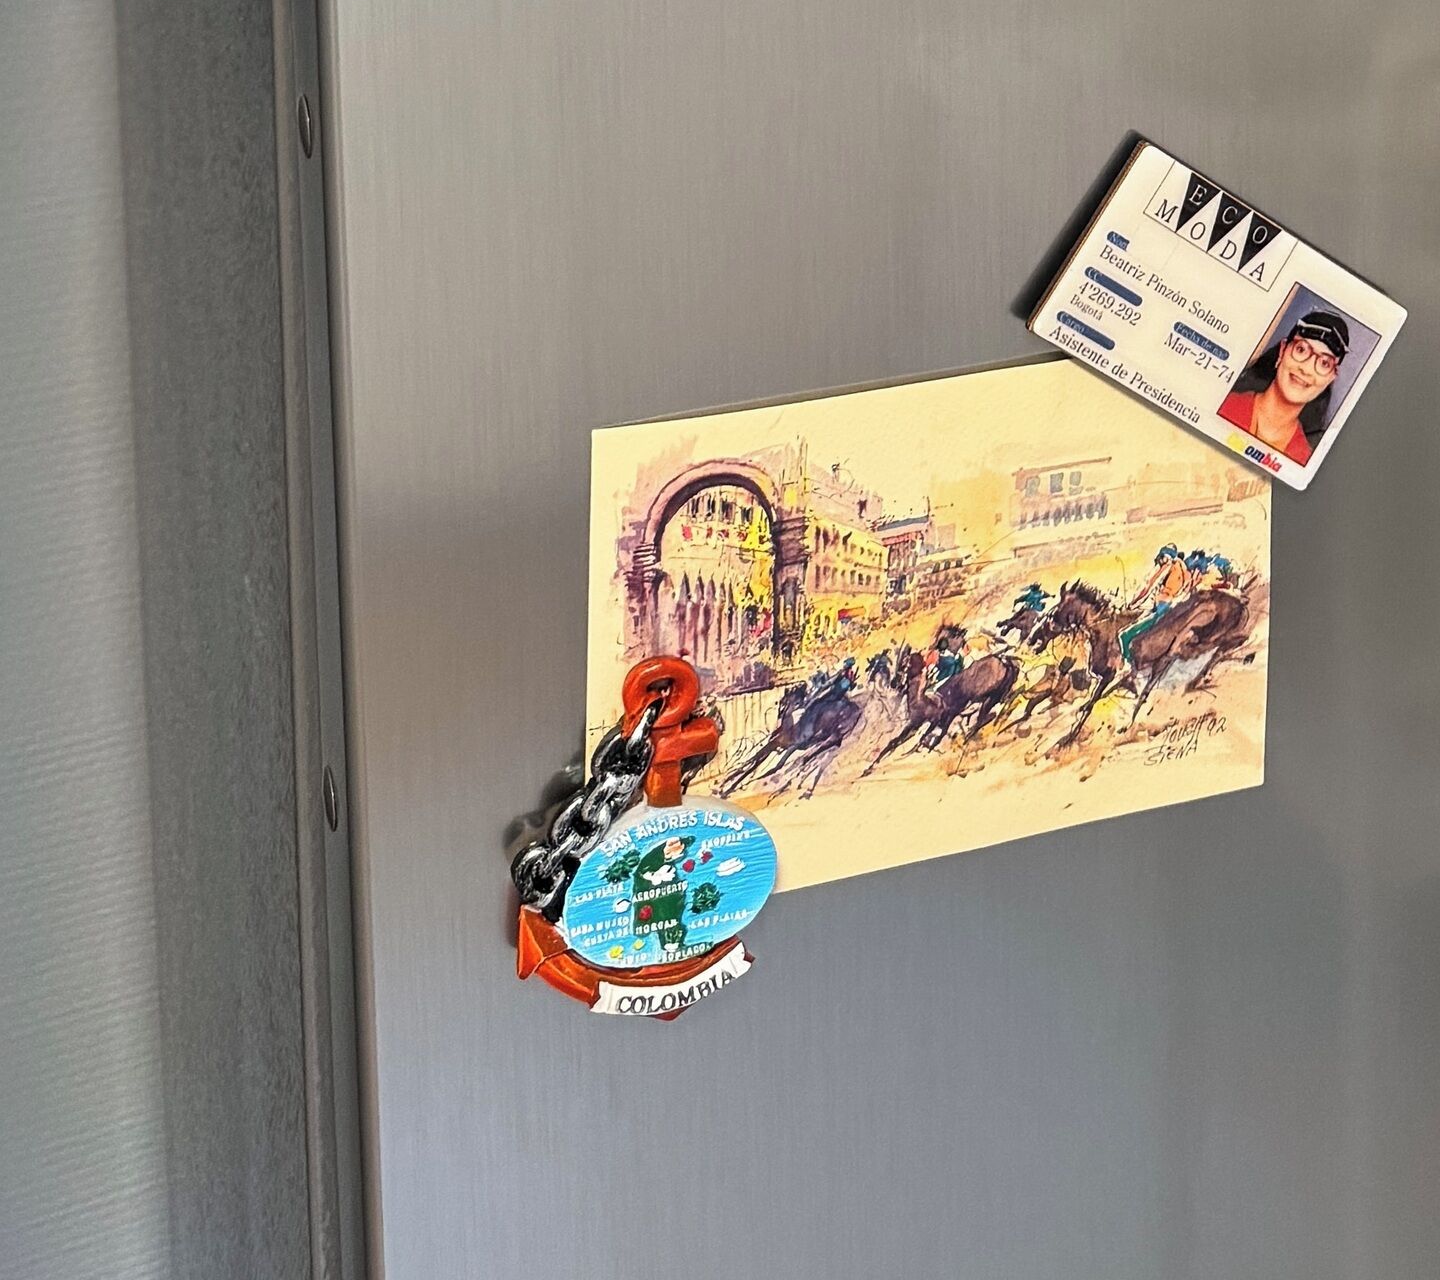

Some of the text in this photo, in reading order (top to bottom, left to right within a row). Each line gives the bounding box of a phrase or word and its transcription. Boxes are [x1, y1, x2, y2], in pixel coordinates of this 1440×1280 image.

[1069, 293, 1104, 322] Bogotá
[1078, 281, 1143, 327] 4'269.292
[1099, 243, 1231, 335] Beatriz Pinzón Solano
[1048, 325, 1202, 425] Asistente de Presidencia
[1163, 331, 1236, 385] Mar-21-74
[601, 811, 747, 858] SAN ANDRES ISLAS
[632, 880, 689, 903] AEROPUERTO
[636, 918, 679, 935] MORGAN
[616, 970, 736, 1015] COLOMBIA
